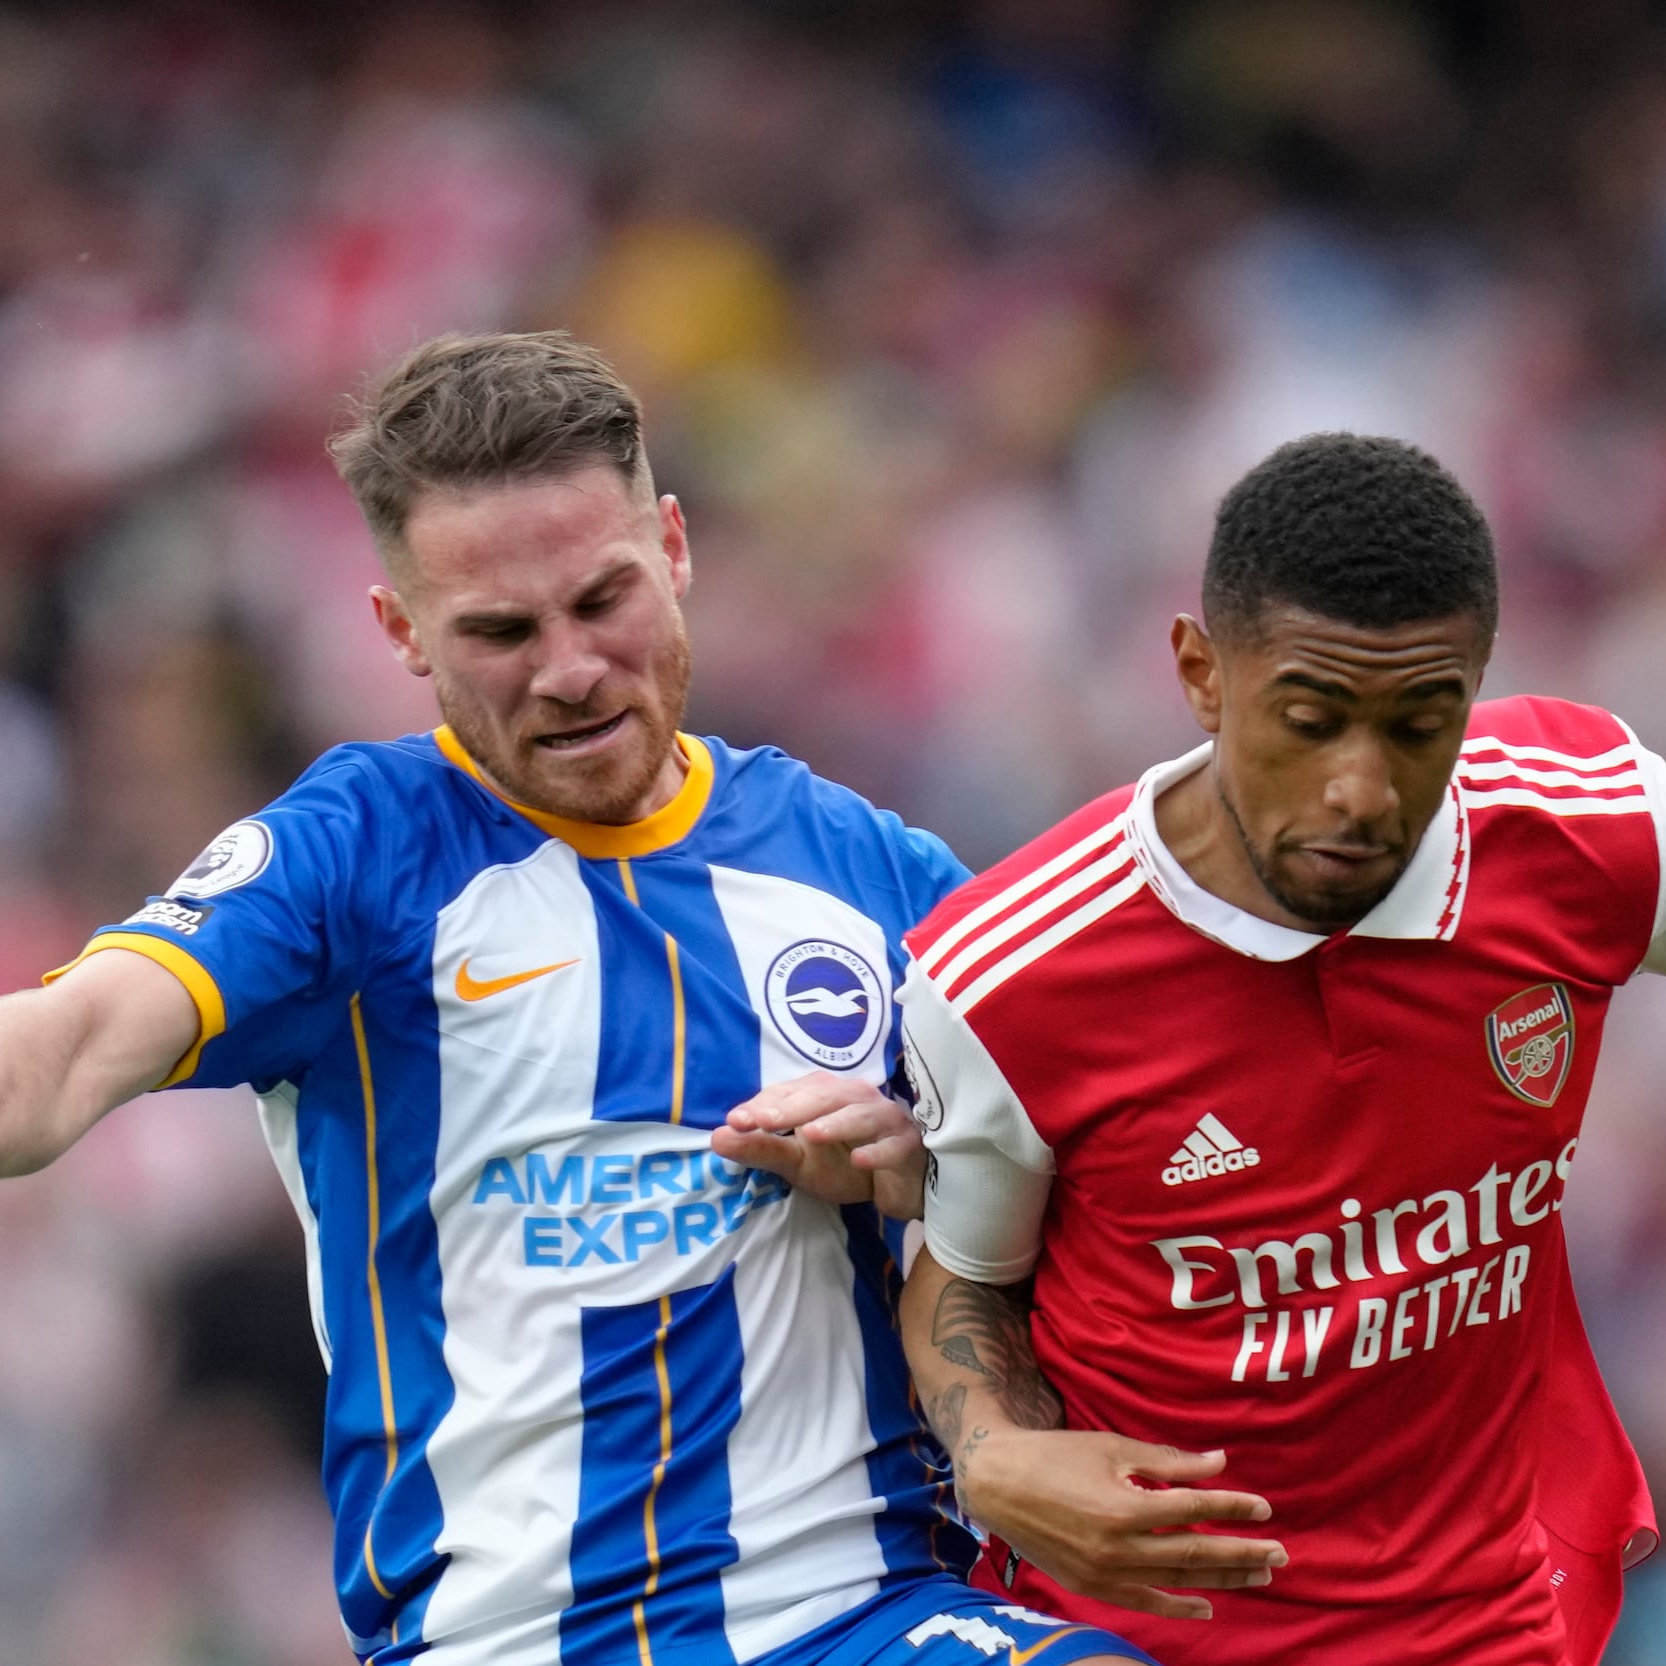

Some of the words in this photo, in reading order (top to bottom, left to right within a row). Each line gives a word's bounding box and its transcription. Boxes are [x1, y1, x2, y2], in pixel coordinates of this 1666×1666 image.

[775, 944, 825, 979] BRIGHTON
[843, 953, 870, 978] HOVE
[1499, 997, 1561, 1042] Arsenal
[814, 1047, 854, 1062] ALBION
[473, 1150, 748, 1206] AMERIC
[1161, 1145, 1261, 1186] adidas
[1149, 1137, 1579, 1310] Emirates
[1231, 1306, 1334, 1382] FLY
[1349, 1244, 1531, 1370] BETTER
